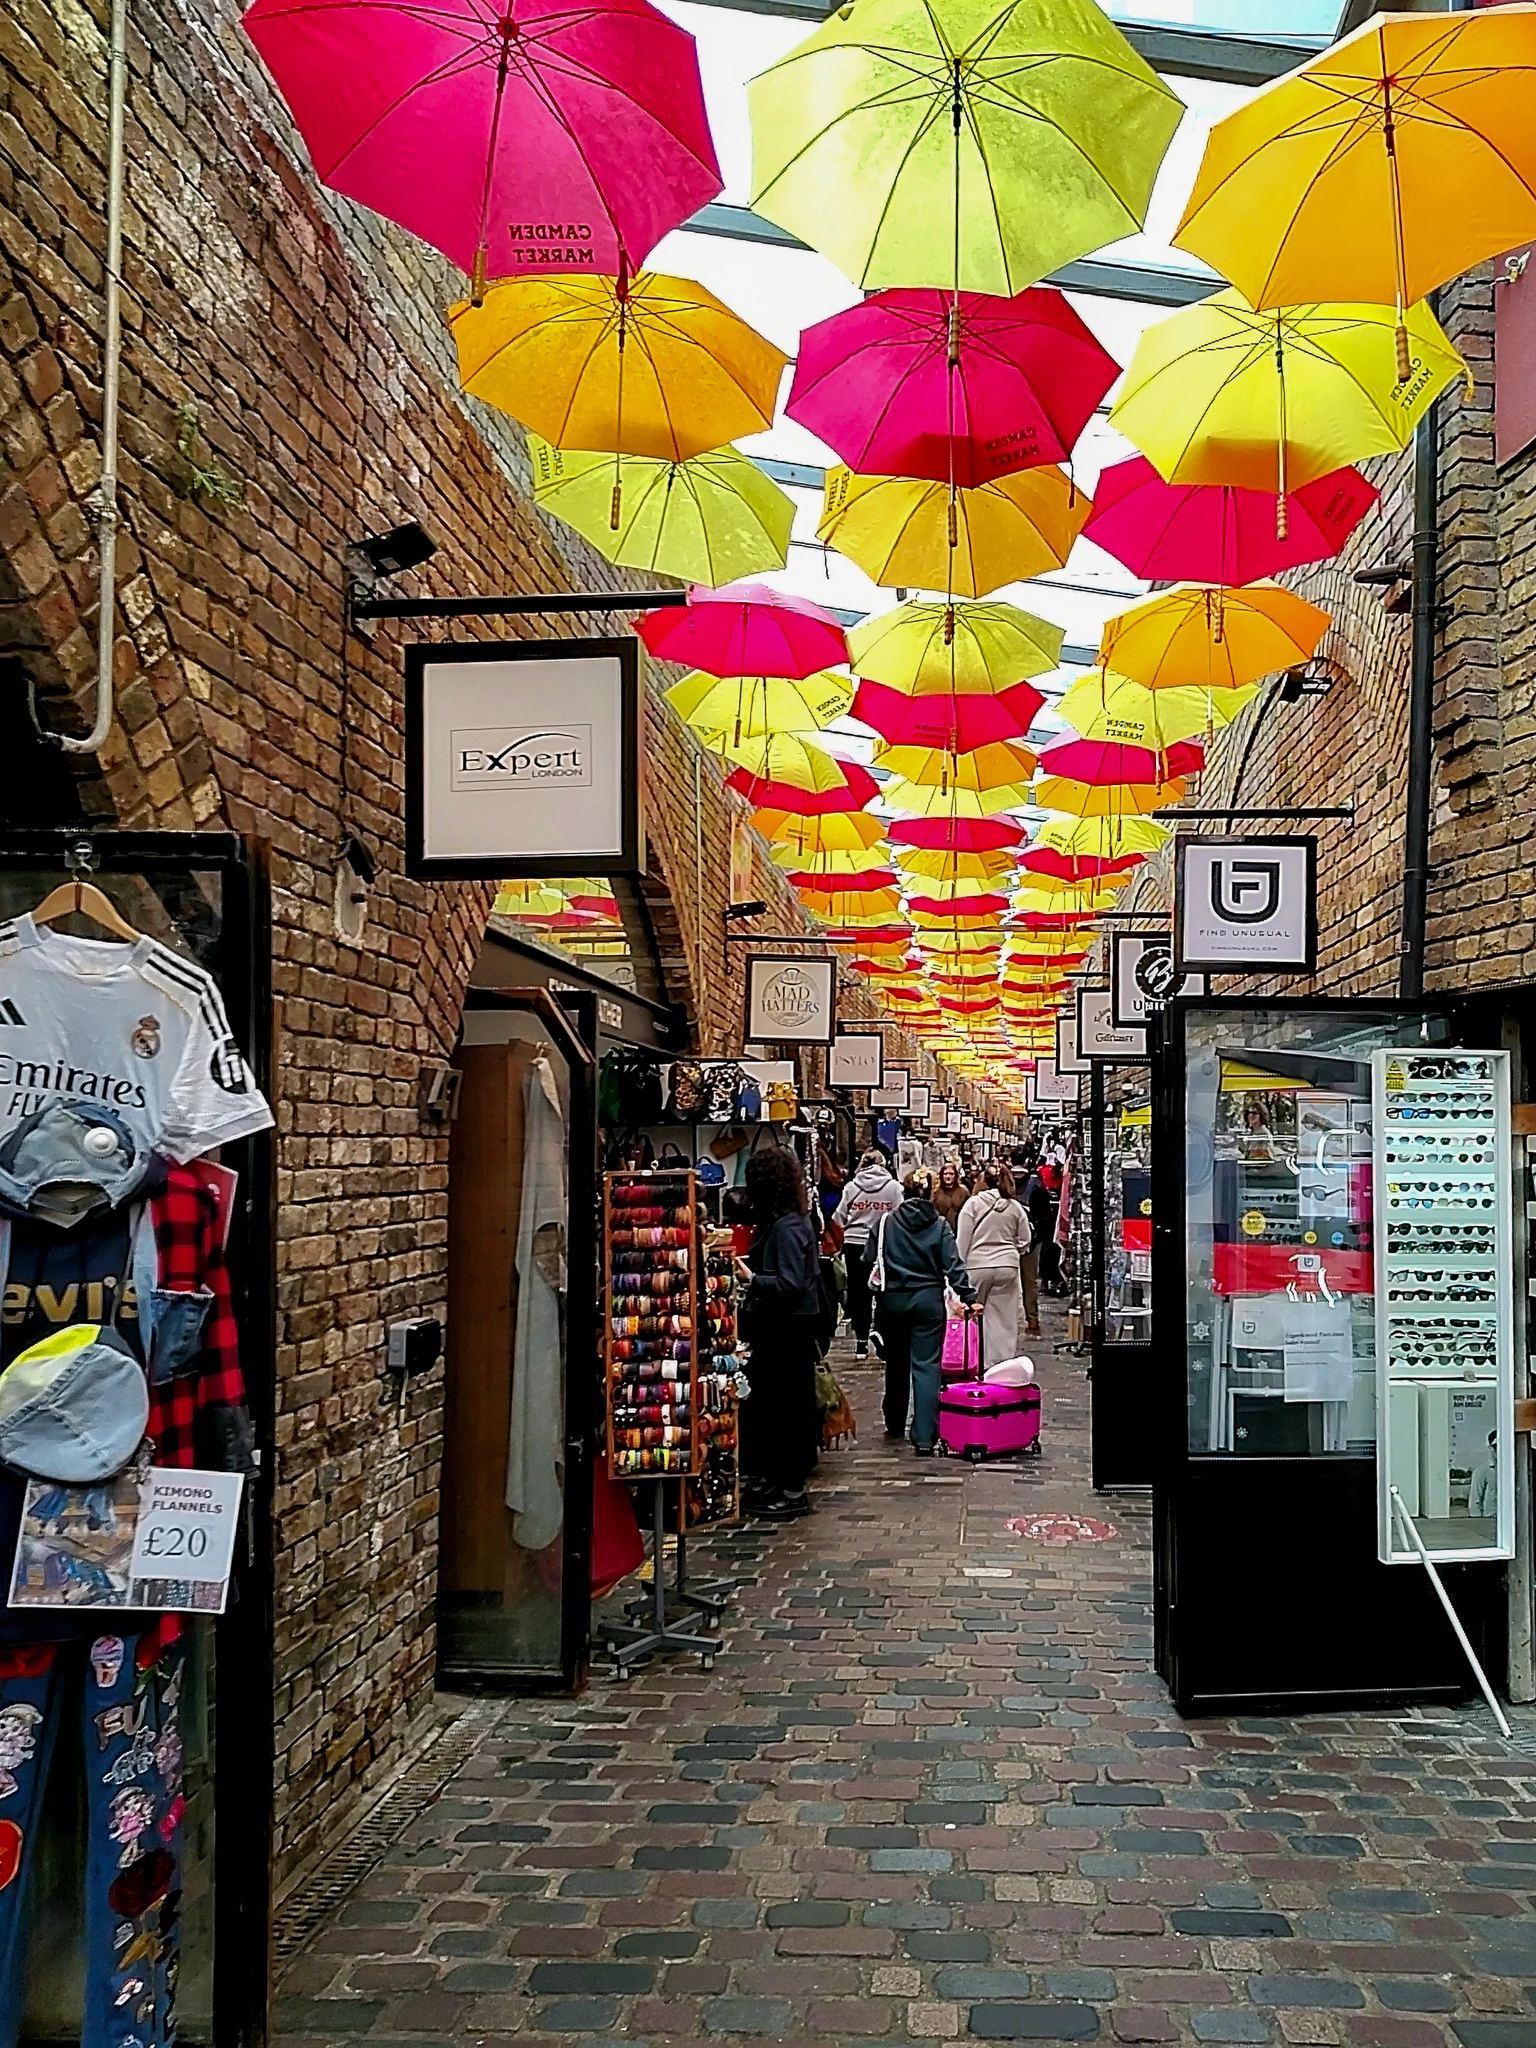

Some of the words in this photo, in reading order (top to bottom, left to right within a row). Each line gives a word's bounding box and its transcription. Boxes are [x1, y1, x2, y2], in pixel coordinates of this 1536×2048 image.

[459, 744, 583, 776] Expert
[531, 768, 583, 778] LONDON
[1199, 929, 1227, 937] FIND
[1232, 930, 1291, 938] UNUSUAL
[774, 986, 810, 1001] MAD
[762, 999, 820, 1014] HATTERS
[7, 1092, 46, 1118] FLY
[154, 1486, 213, 1499] KIMONO
[152, 1500, 223, 1514] FLANNELS
[141, 1526, 207, 1557] £20
